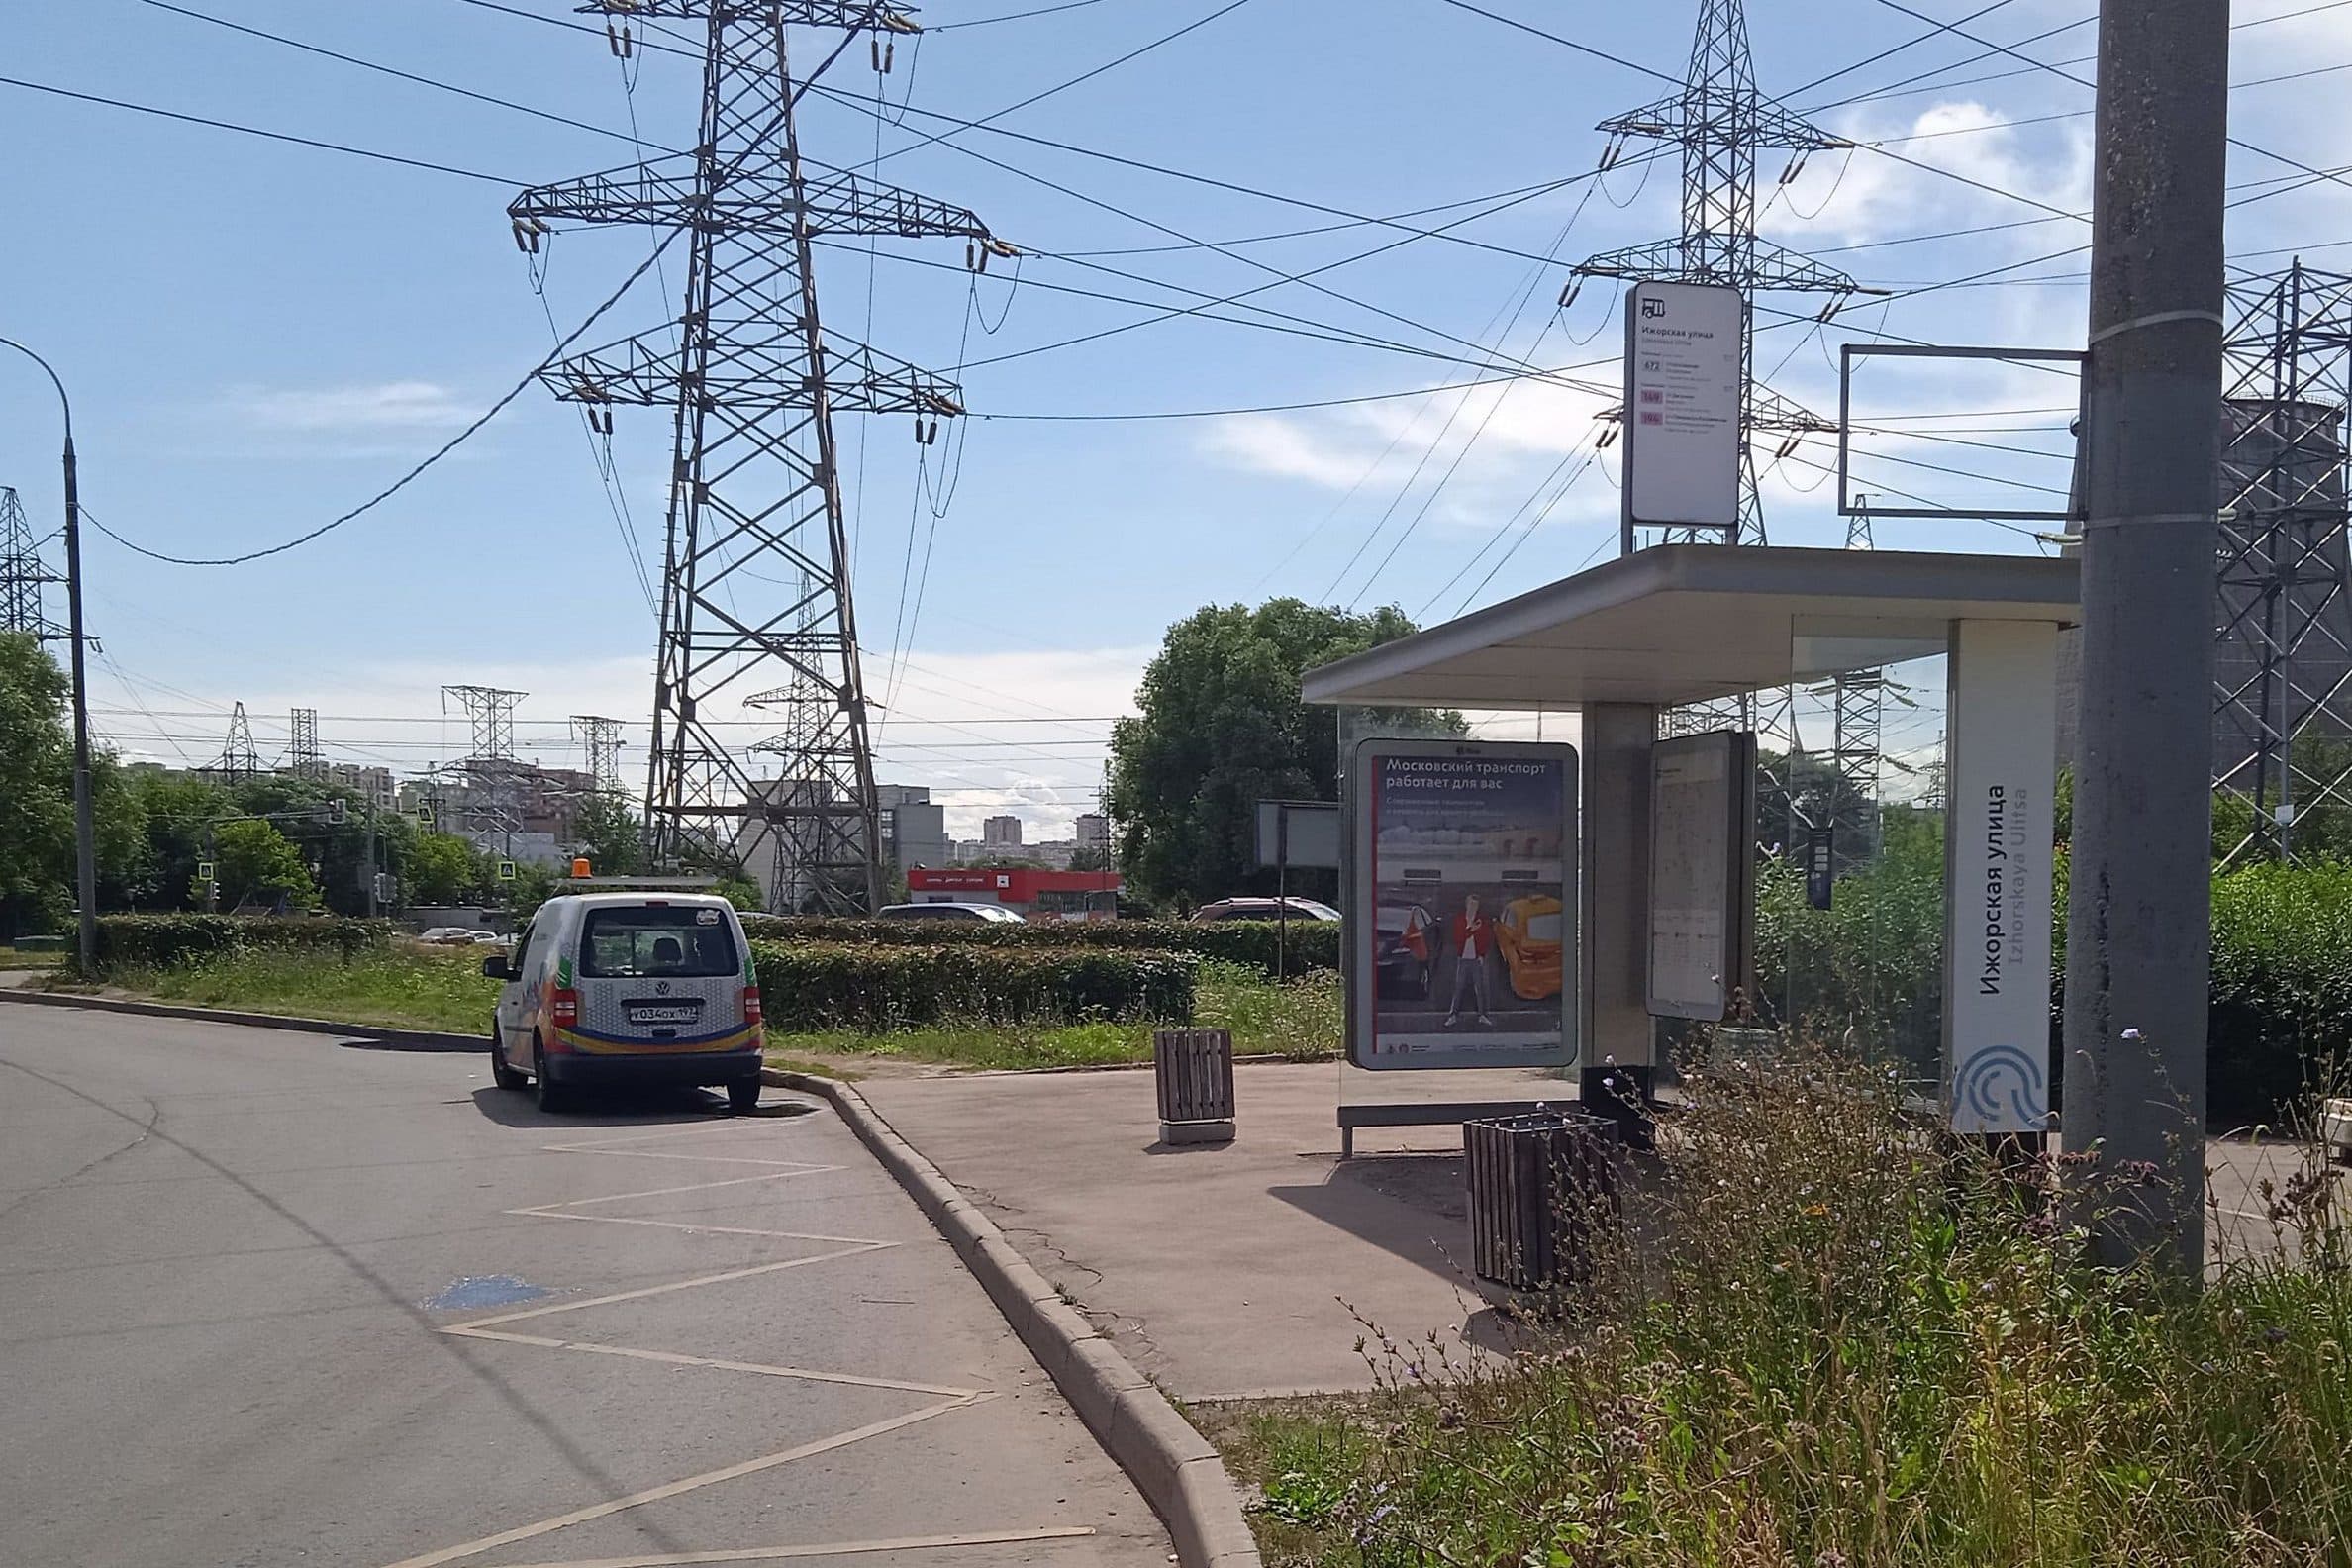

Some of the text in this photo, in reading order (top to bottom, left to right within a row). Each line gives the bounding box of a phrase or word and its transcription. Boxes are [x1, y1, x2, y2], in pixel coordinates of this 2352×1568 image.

[1642, 326, 1686, 337] Ижорская
[1386, 758, 1546, 776] Московский транспорт
[1386, 775, 1503, 790] работает для вас
[2008, 788, 2027, 965] Izhorskaya Ulitsa
[1980, 784, 2008, 995] Ижорская улица
